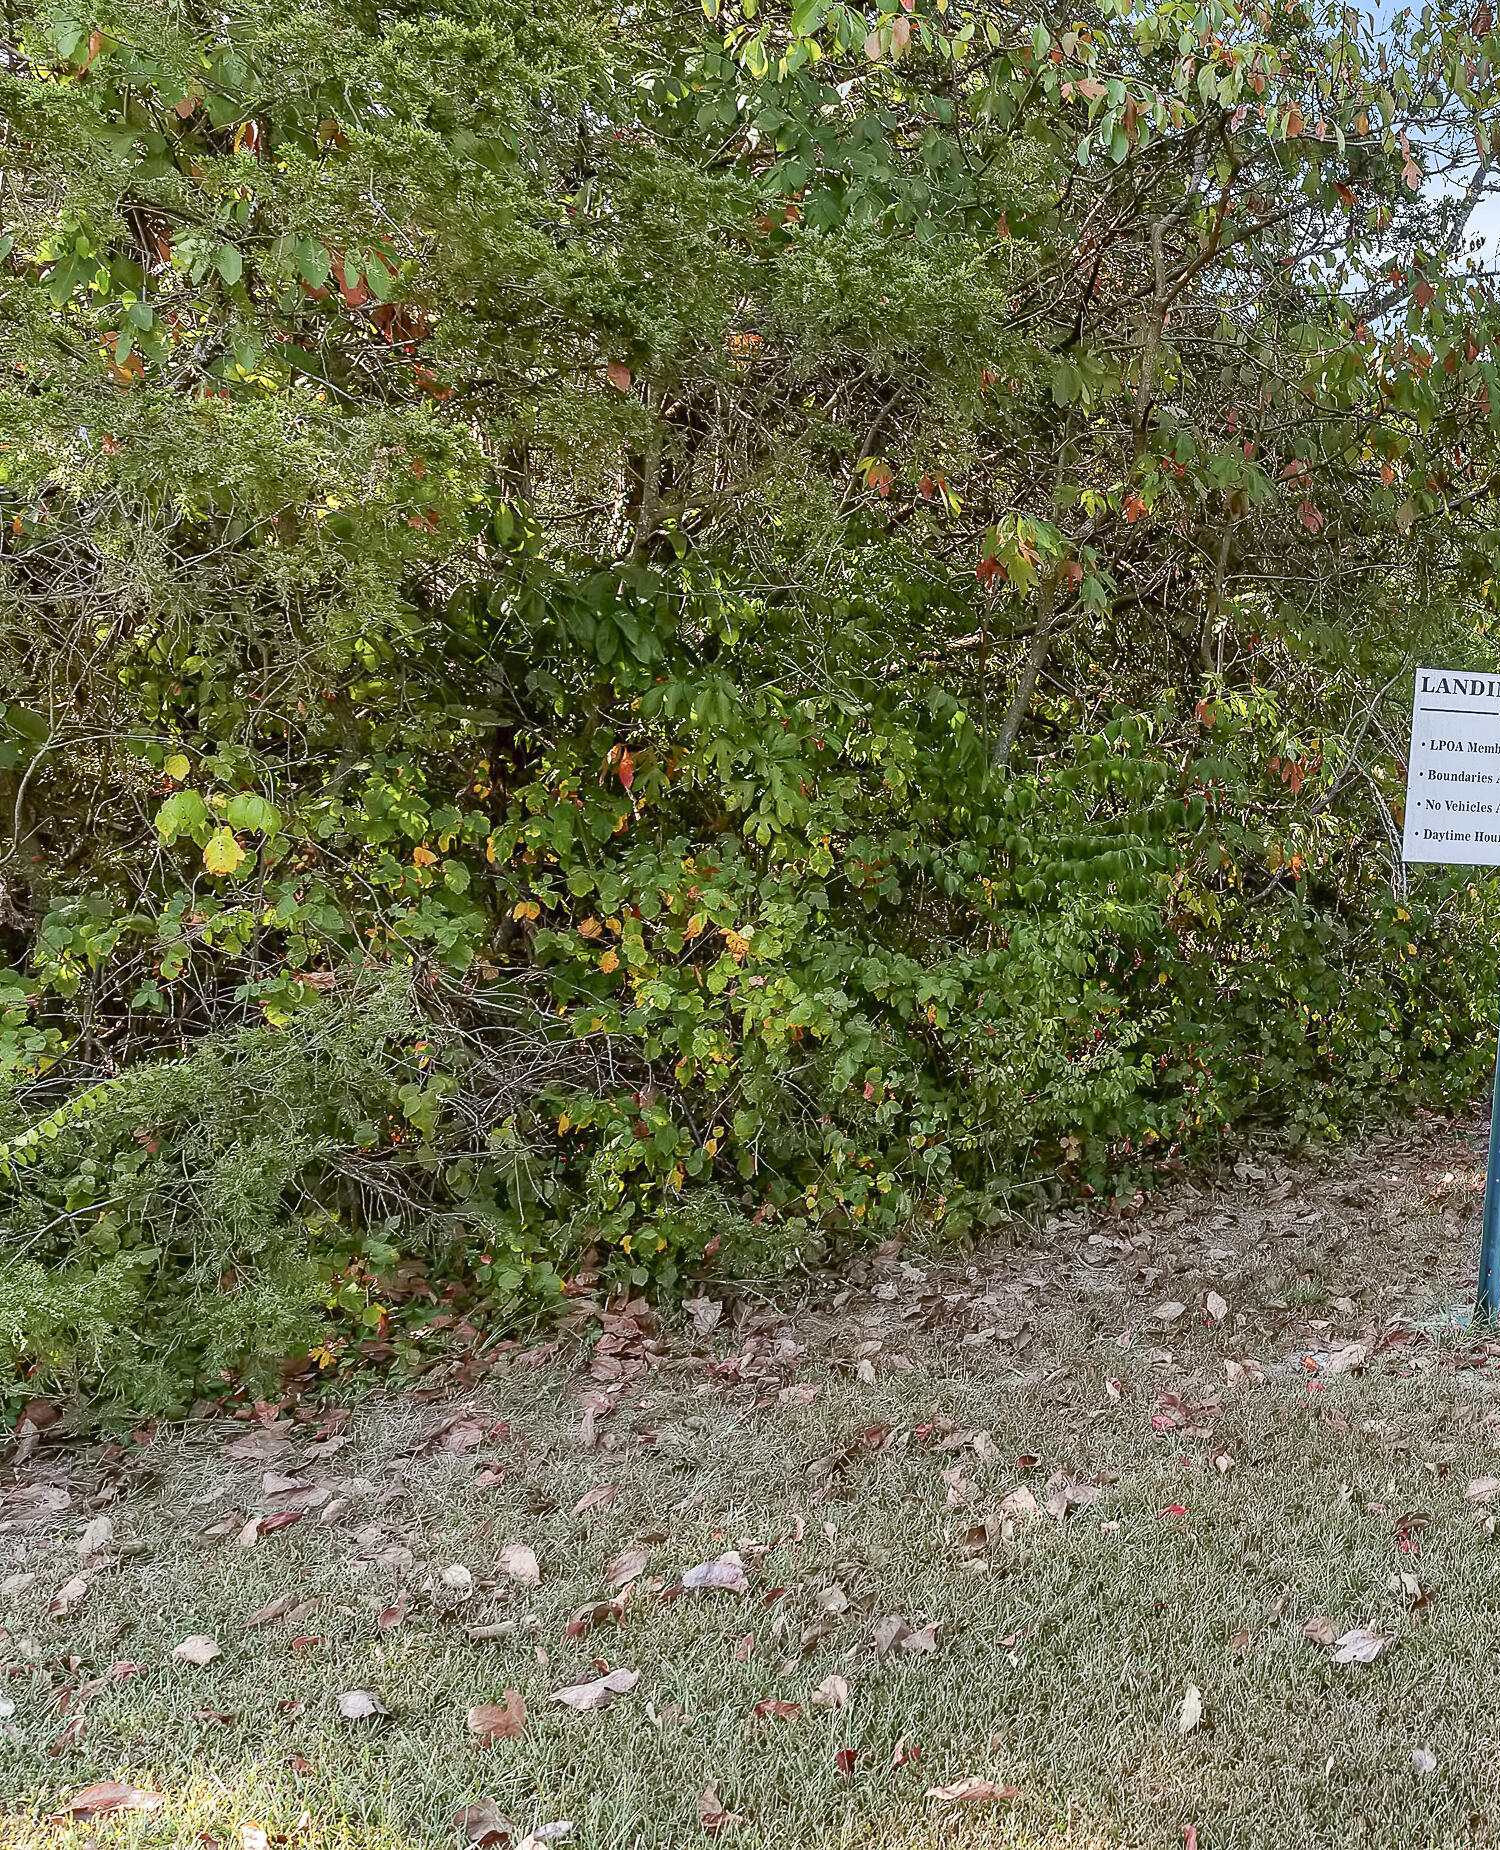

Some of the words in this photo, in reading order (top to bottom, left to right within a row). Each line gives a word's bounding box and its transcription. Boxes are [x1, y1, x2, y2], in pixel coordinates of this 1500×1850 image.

[1430, 740, 1464, 752] LPOA
[1428, 770, 1493, 784] Boundaries
[1426, 799, 1441, 810] No
[1445, 800, 1493, 813] Vehicles
[1423, 829, 1471, 844] Daytime
